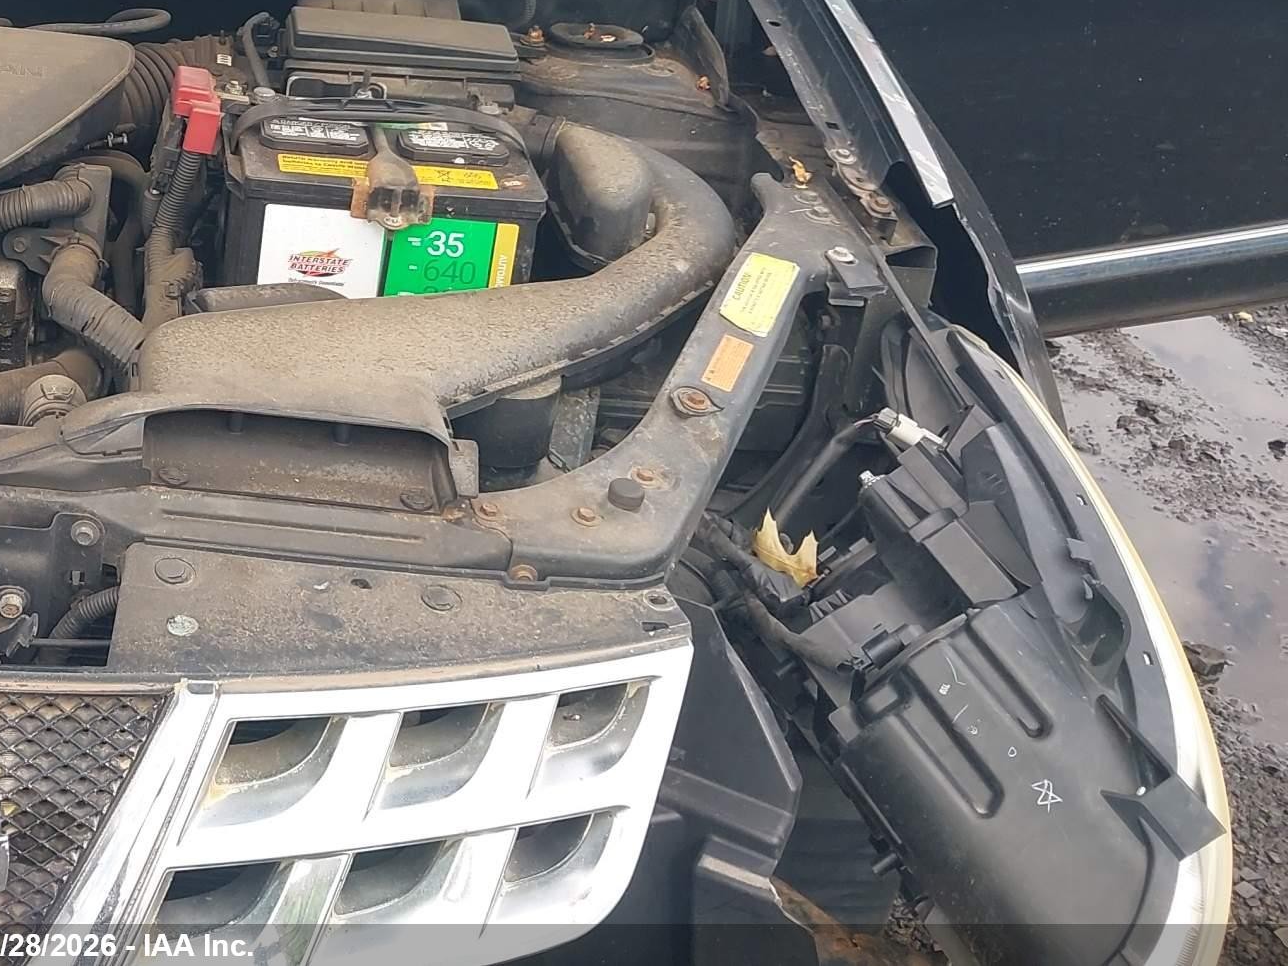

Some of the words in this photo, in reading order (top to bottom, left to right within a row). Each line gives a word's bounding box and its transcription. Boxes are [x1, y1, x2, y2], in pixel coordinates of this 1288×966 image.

[426, 230, 465, 257] 35
[288, 253, 349, 266] INTERSTATE
[290, 262, 345, 273] BATTERIES
[423, 258, 476, 285] 640
